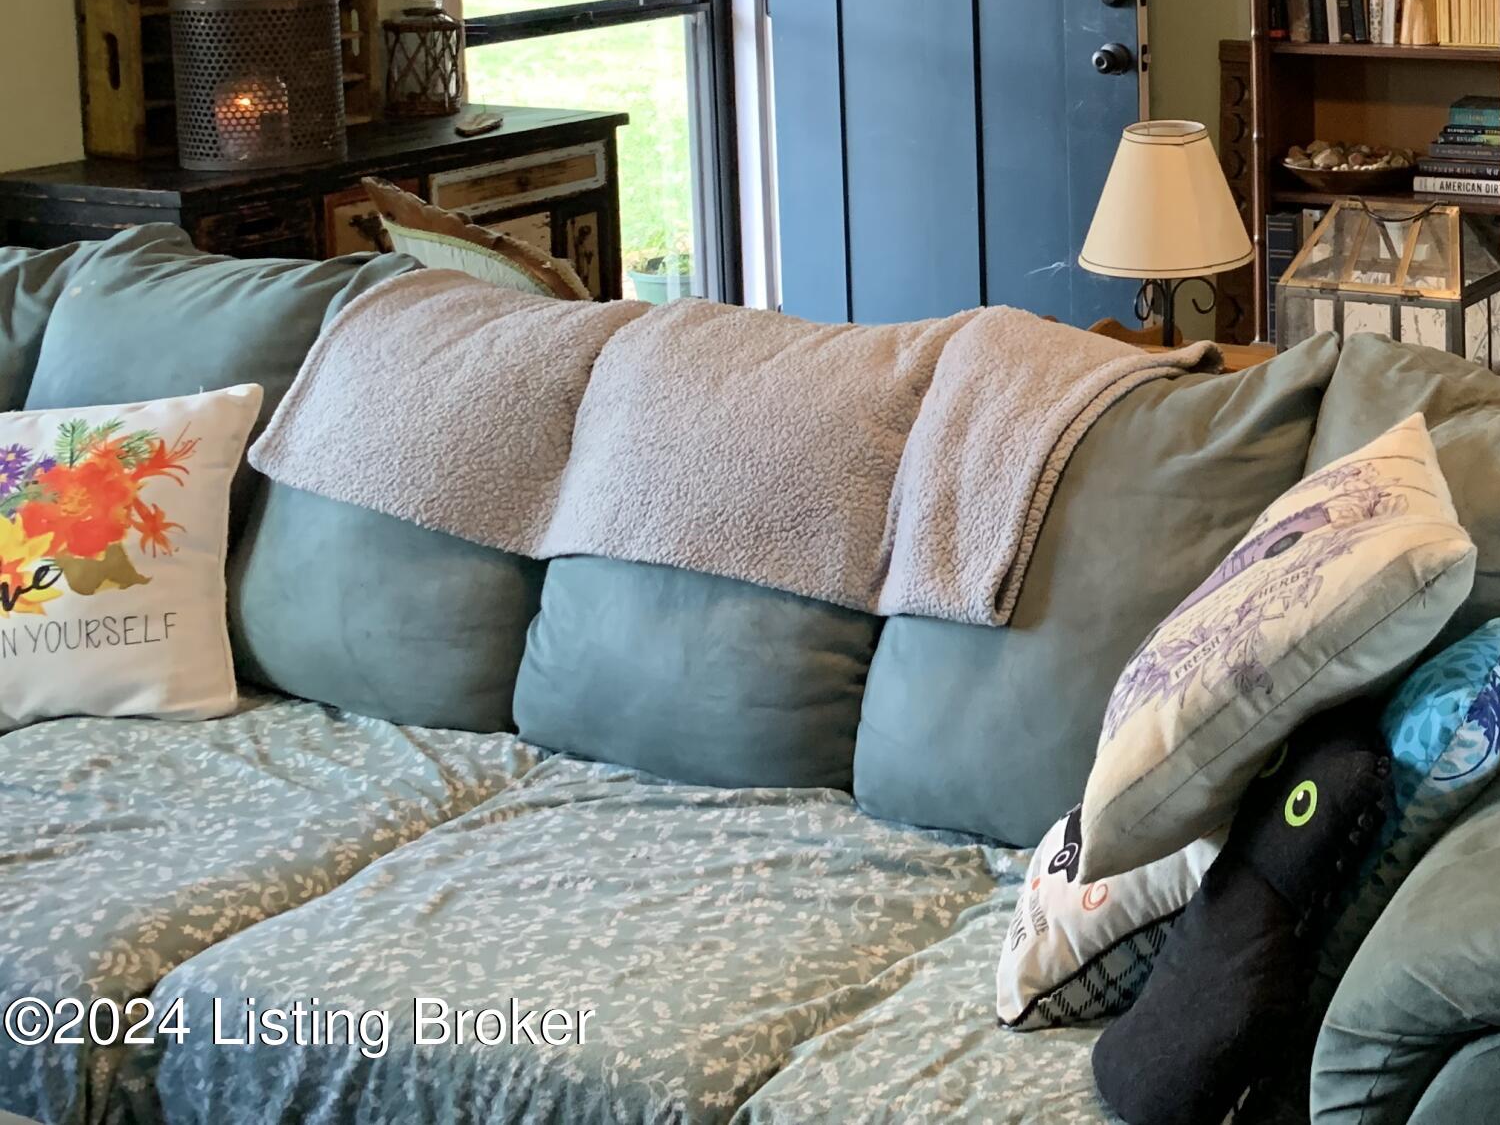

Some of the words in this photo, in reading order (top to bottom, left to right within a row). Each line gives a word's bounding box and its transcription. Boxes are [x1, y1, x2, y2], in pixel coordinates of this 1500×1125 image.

[1439, 180, 1482, 194] AMERICAN
[1257, 567, 1311, 600] HERBS
[24, 612, 177, 654] YOURSELF
[1173, 635, 1221, 681] FRESH
